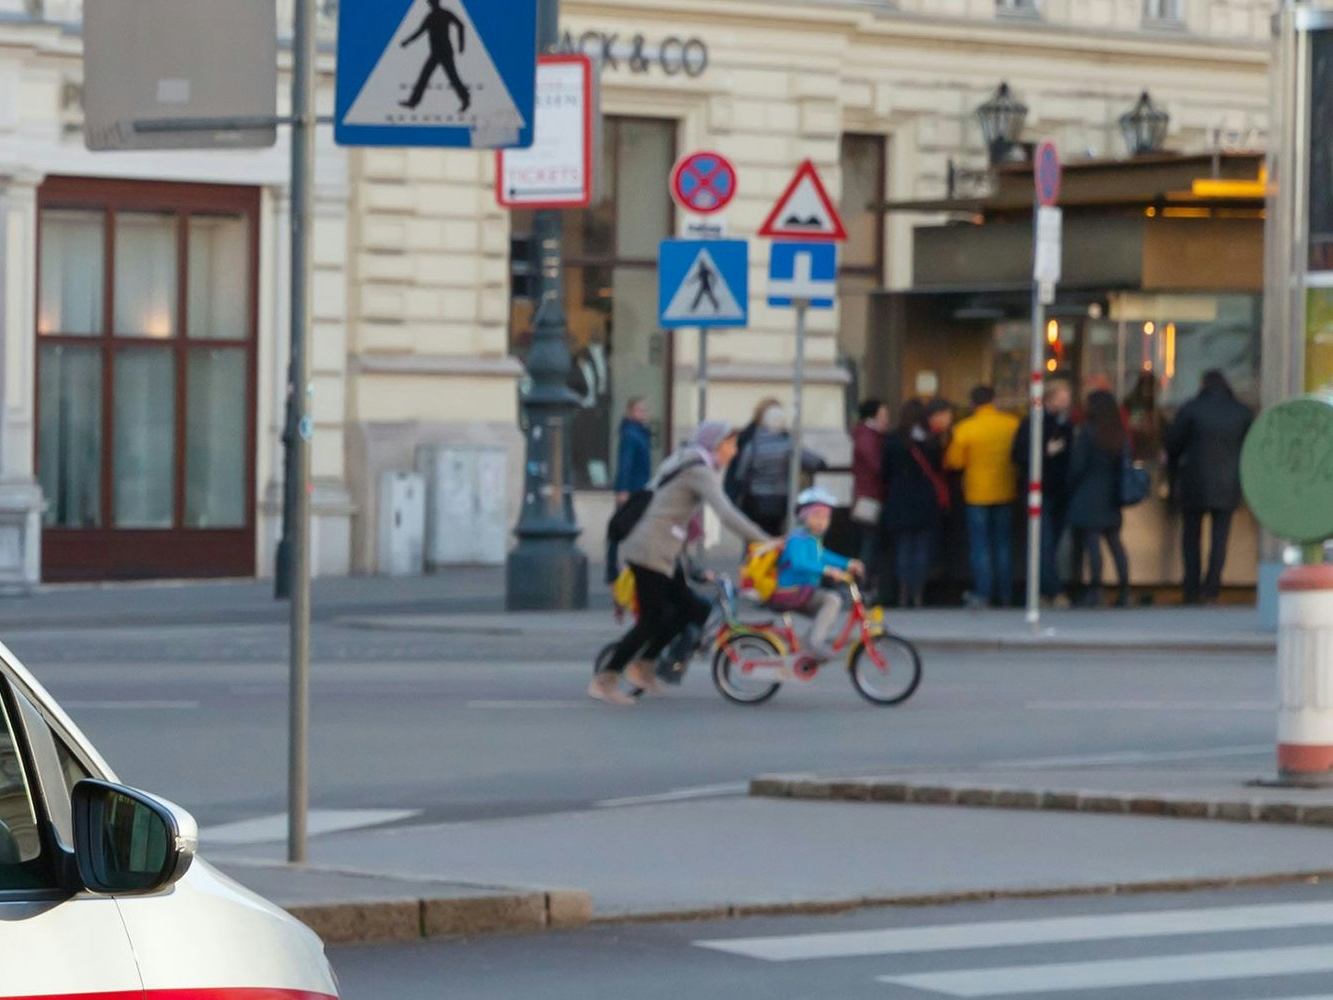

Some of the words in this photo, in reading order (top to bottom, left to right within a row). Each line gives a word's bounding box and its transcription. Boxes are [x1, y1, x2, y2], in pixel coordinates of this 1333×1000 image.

[629, 32, 650, 74] &
[660, 36, 709, 78] CO
[508, 166, 580, 184] TICKETS
